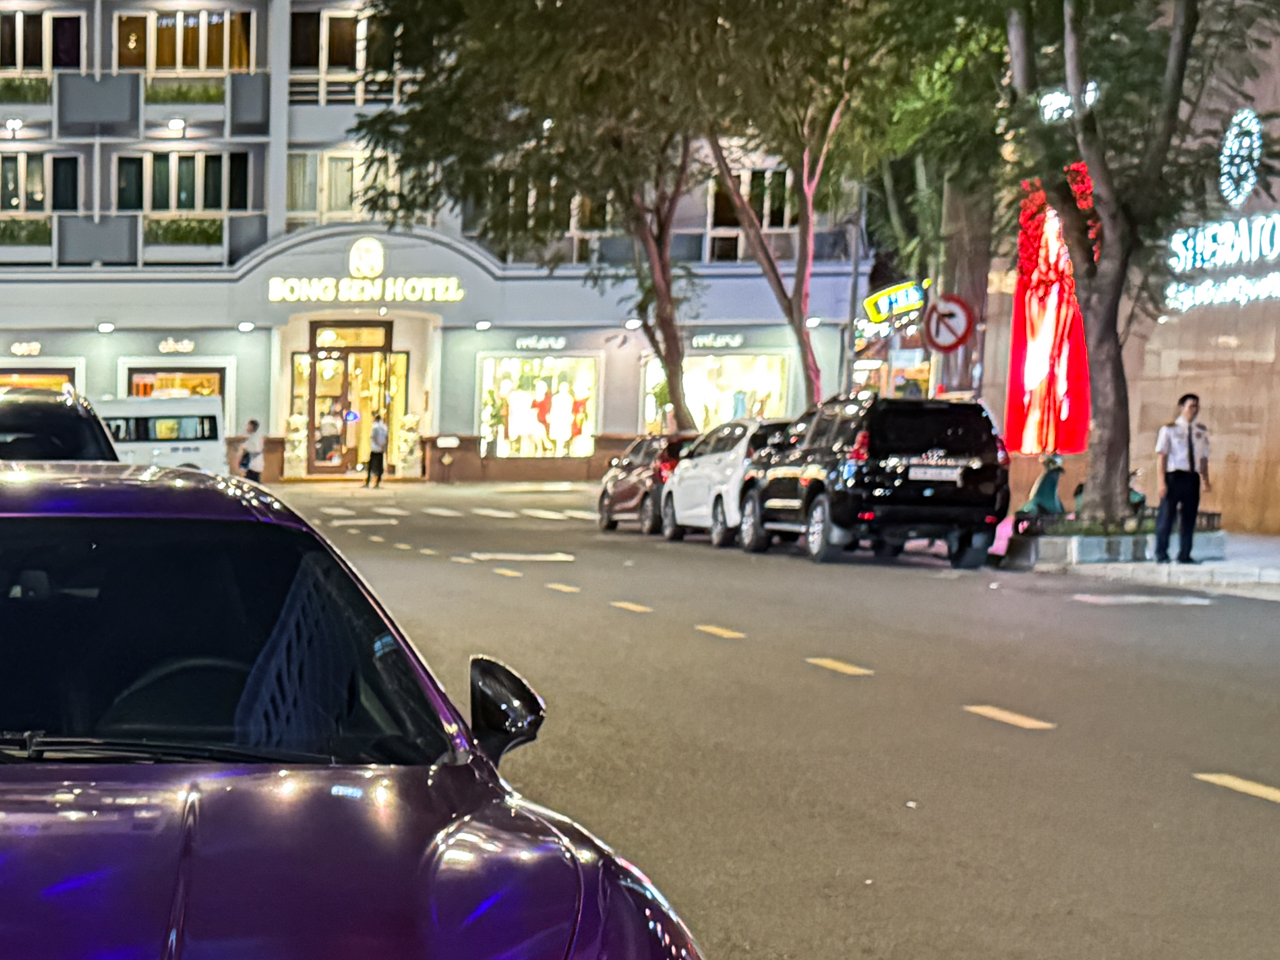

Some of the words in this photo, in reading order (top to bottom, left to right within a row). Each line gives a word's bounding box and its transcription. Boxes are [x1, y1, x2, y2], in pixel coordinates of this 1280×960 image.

[269, 277, 337, 301] BONG
[338, 277, 383, 301] SEN
[384, 277, 465, 301] HOTEL
